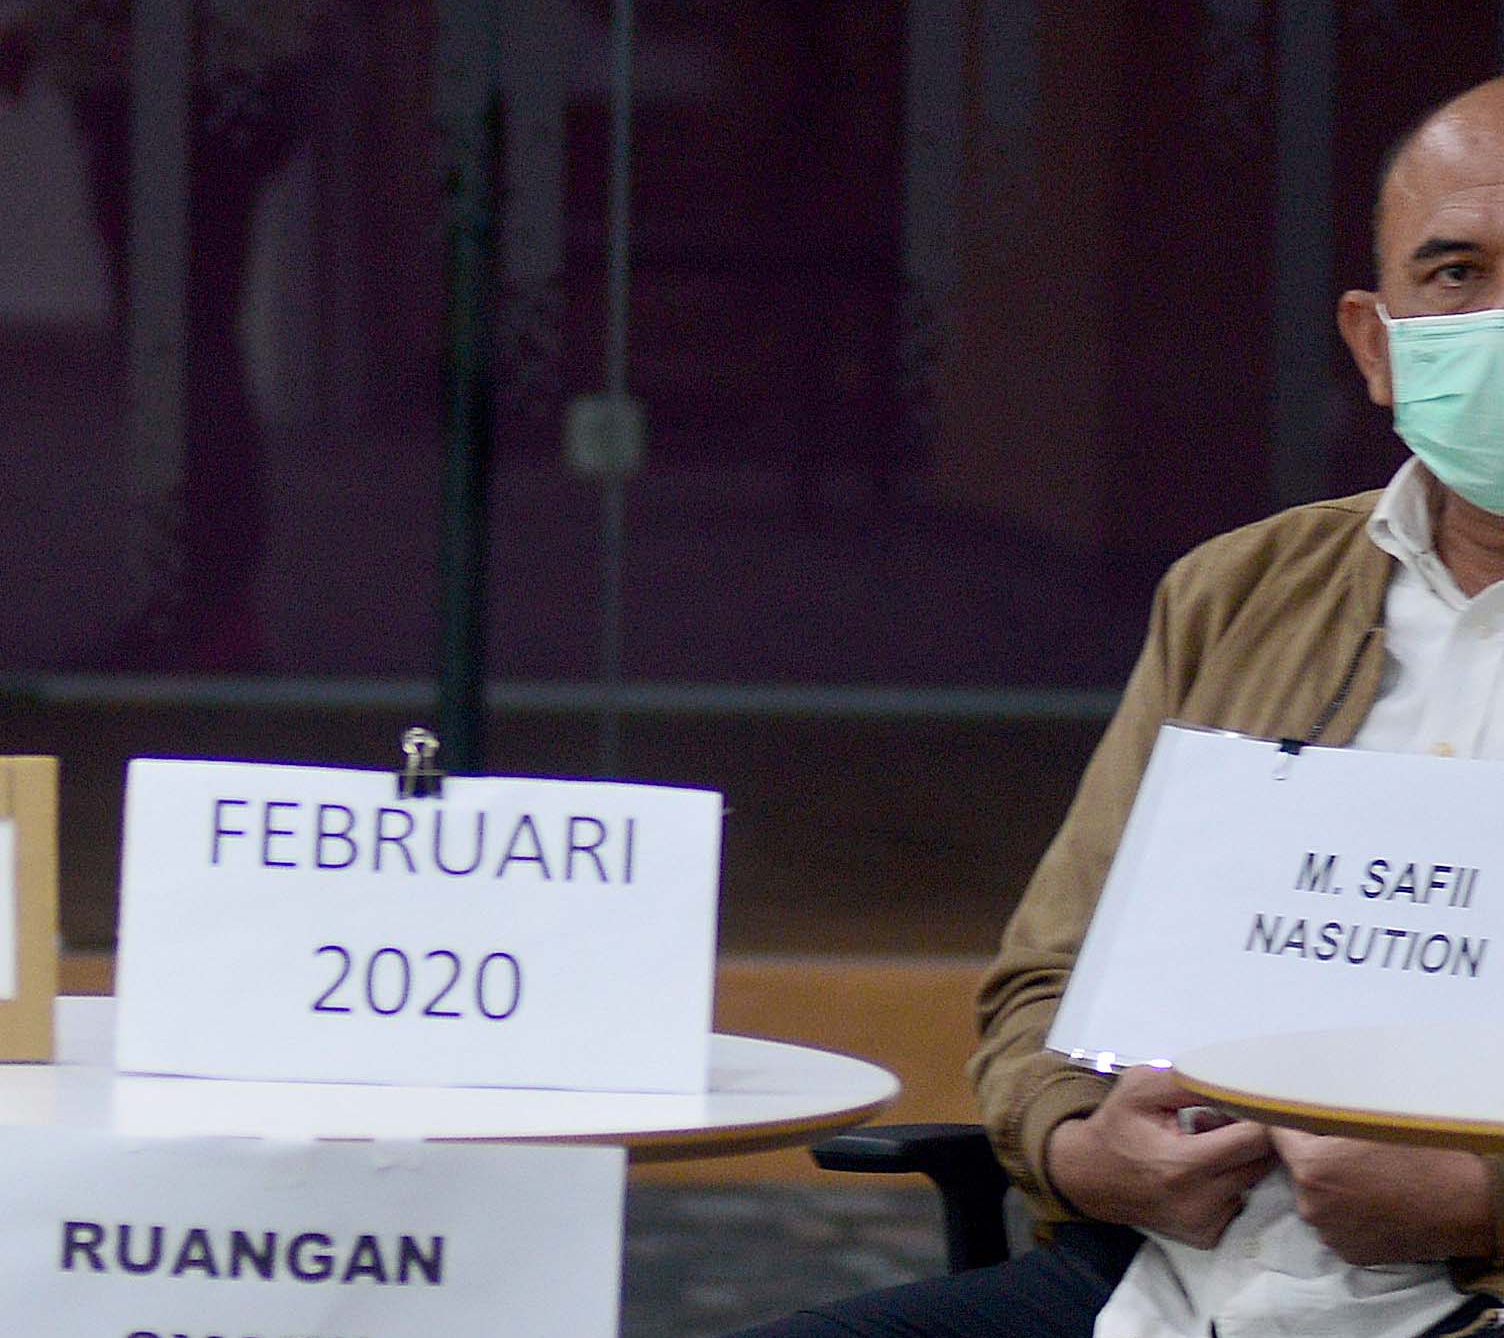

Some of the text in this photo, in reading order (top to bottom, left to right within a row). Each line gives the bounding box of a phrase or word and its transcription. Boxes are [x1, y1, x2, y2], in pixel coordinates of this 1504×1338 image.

[209, 797, 638, 885] FEBRUARI
[1295, 850, 1481, 910] M. SAFII
[1243, 911, 1489, 979] NASUTION
[310, 942, 524, 1023] 2020
[59, 1219, 446, 1287] RUANGAN
